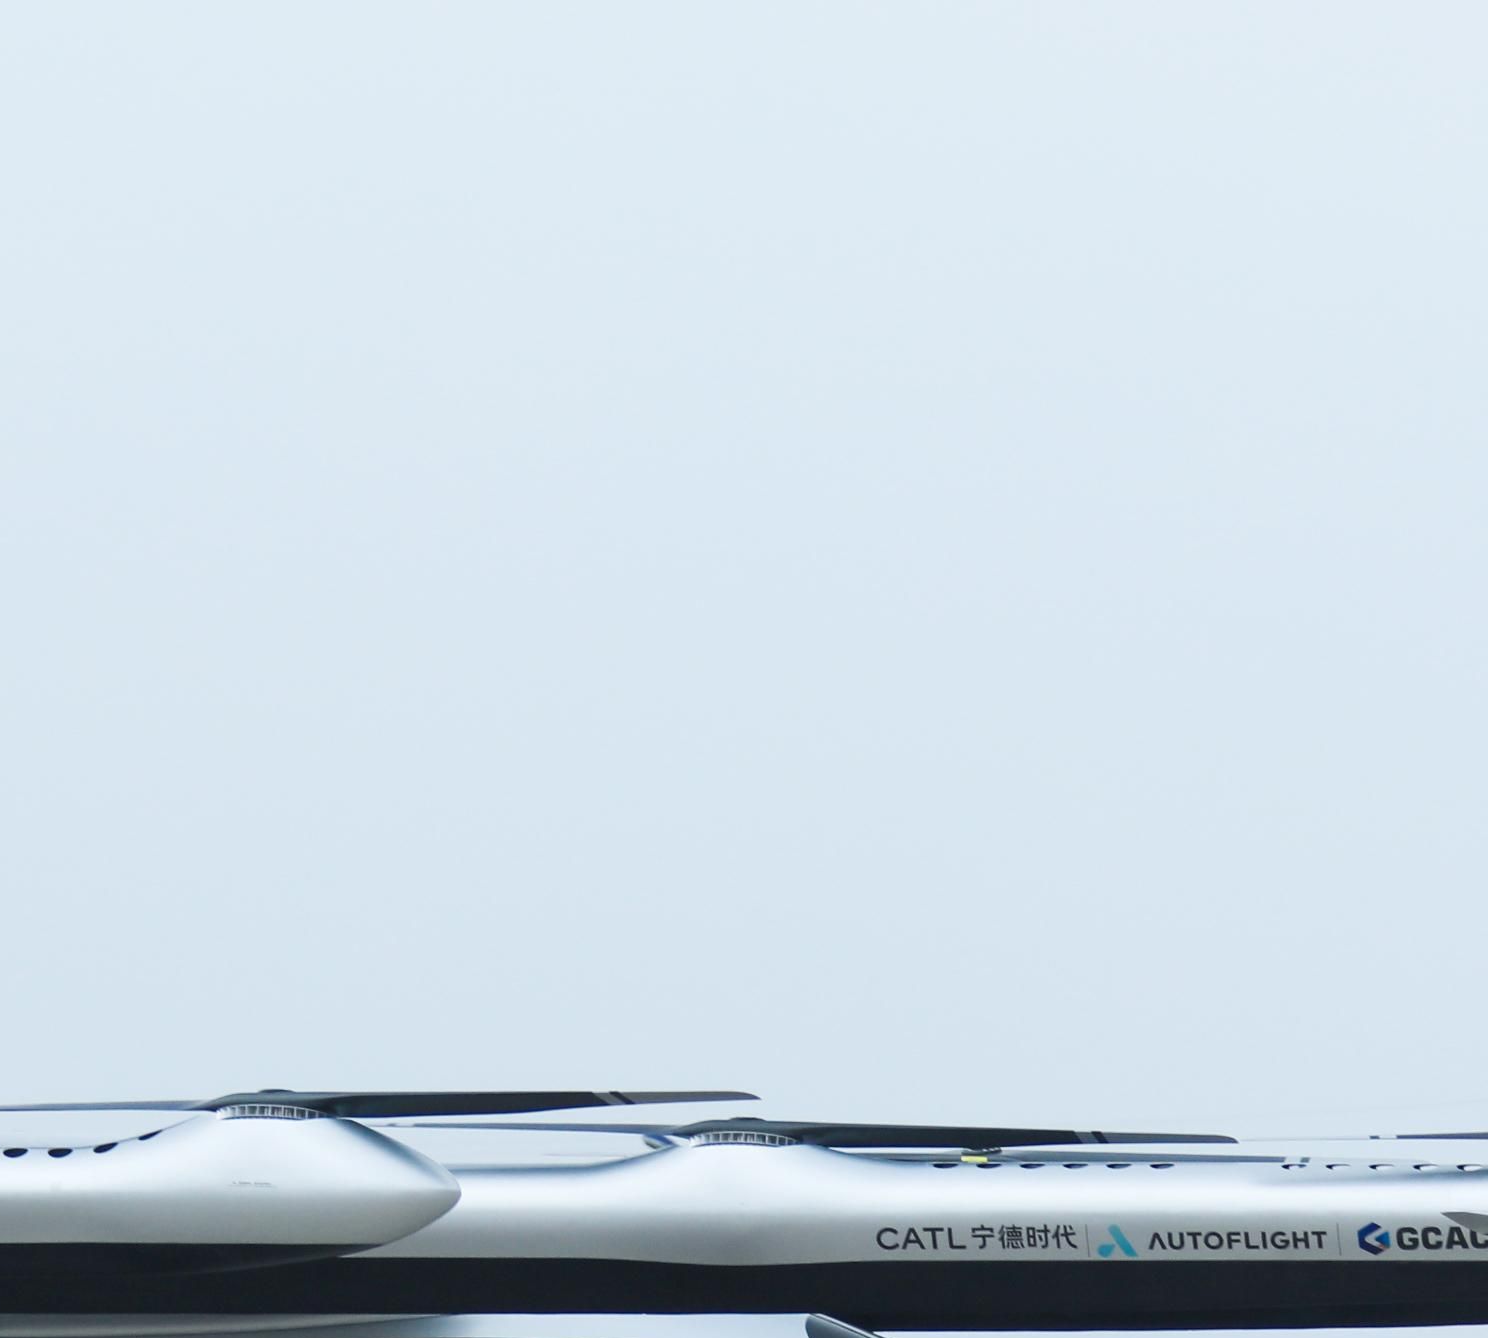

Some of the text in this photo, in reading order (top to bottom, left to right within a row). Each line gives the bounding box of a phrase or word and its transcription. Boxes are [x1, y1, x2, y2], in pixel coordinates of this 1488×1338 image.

[875, 1224, 1078, 1251] CATL 宁德时代
[1148, 1230, 1327, 1251] AUTOFLIGHT
